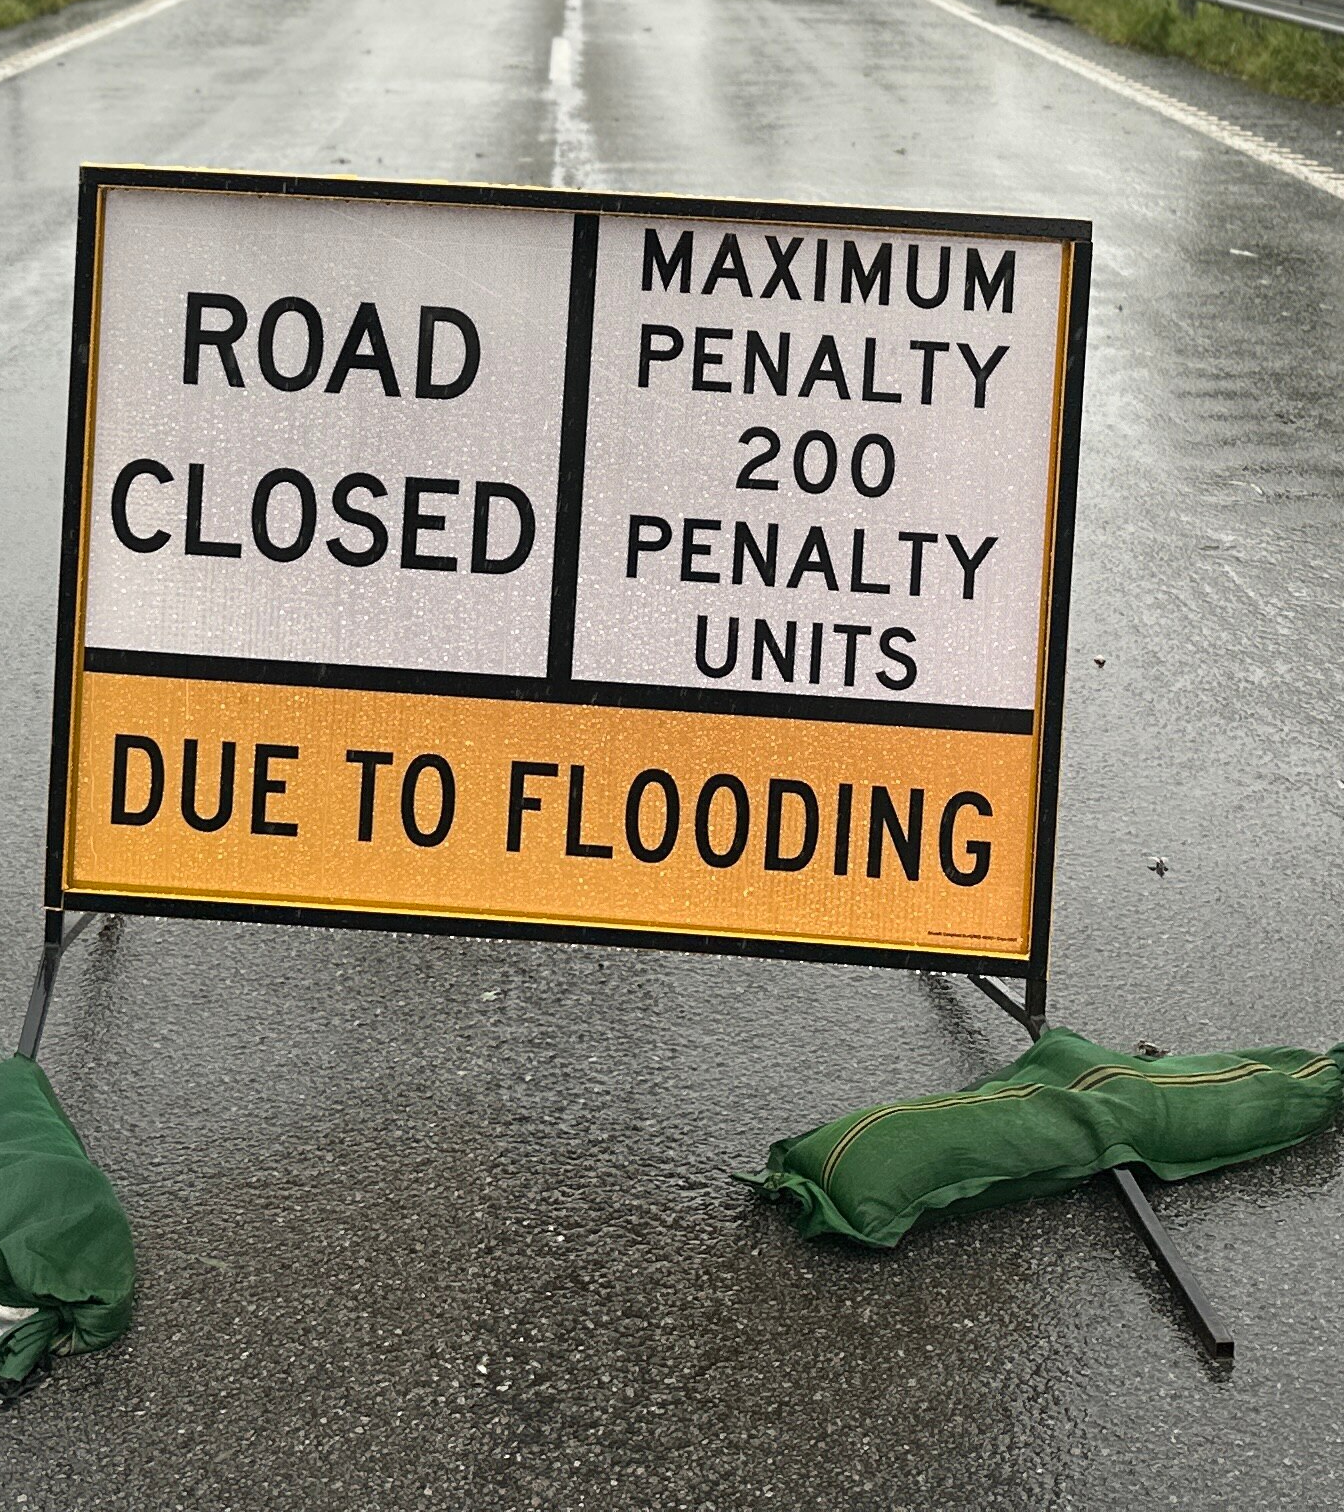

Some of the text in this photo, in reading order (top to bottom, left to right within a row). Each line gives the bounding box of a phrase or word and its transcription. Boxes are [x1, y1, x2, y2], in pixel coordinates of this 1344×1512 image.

[641, 227, 1016, 314] MAXIMUM
[182, 291, 482, 400] ROAD
[637, 323, 1010, 409] PENALTY
[735, 426, 896, 499] 200
[111, 458, 537, 575] CLOSED
[625, 514, 999, 600] PENALTY
[694, 614, 918, 692] UNITS
[110, 733, 995, 888] DUE TO FLOODING
